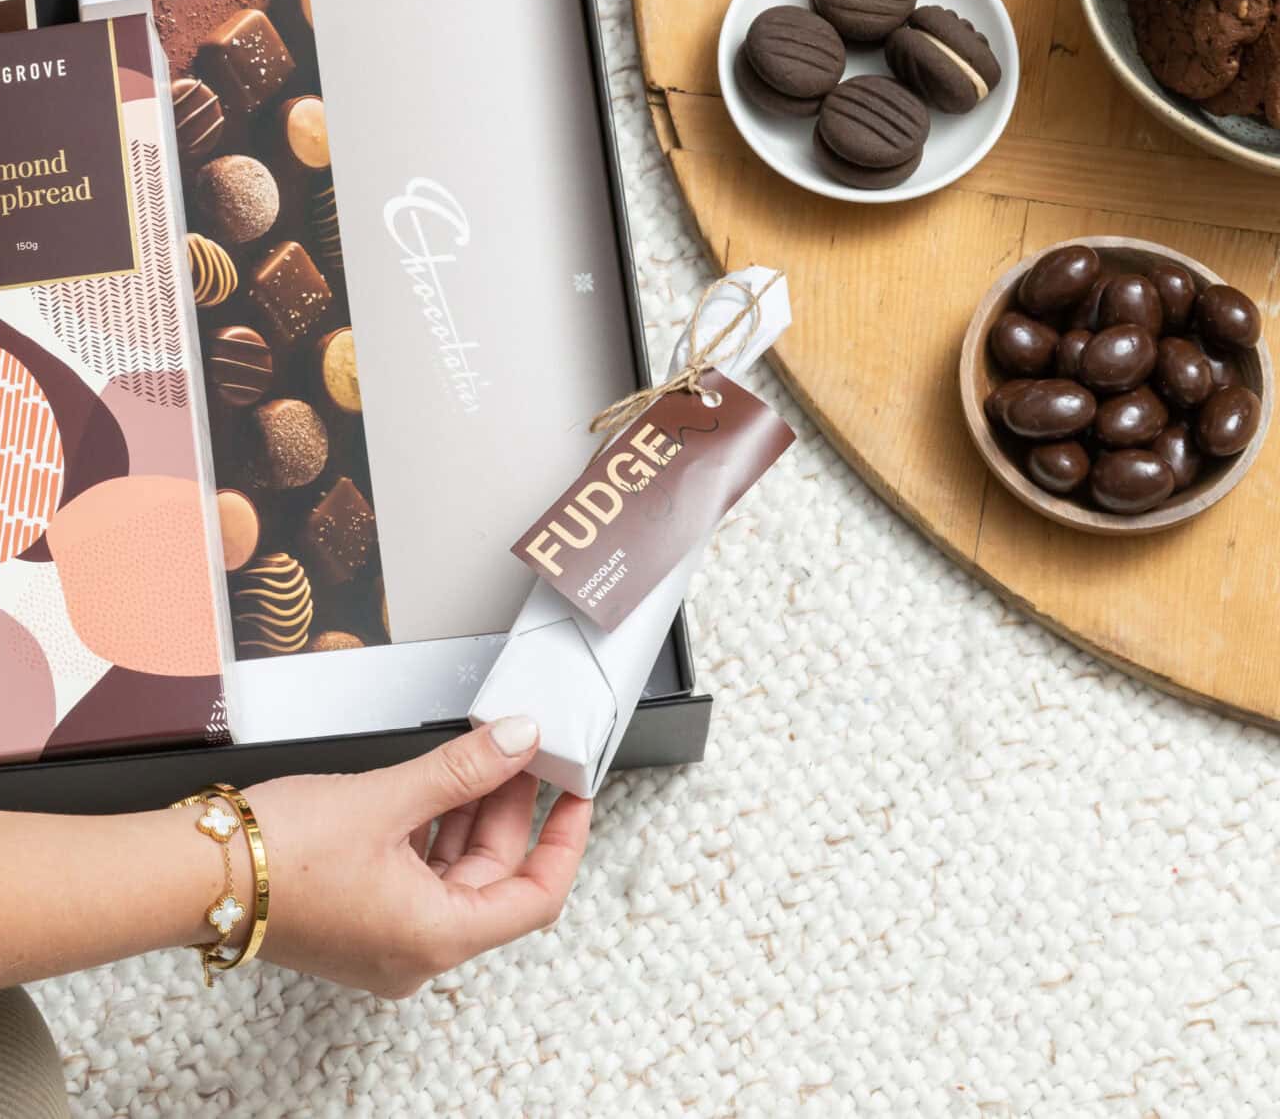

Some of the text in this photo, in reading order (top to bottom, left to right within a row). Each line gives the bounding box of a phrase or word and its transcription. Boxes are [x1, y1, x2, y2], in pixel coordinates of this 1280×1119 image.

[15, 241, 39, 252] 150g
[525, 423, 683, 577] FUDGE
[577, 548, 627, 599] CHOCOLATE
[587, 564, 629, 608] & WALNUT
